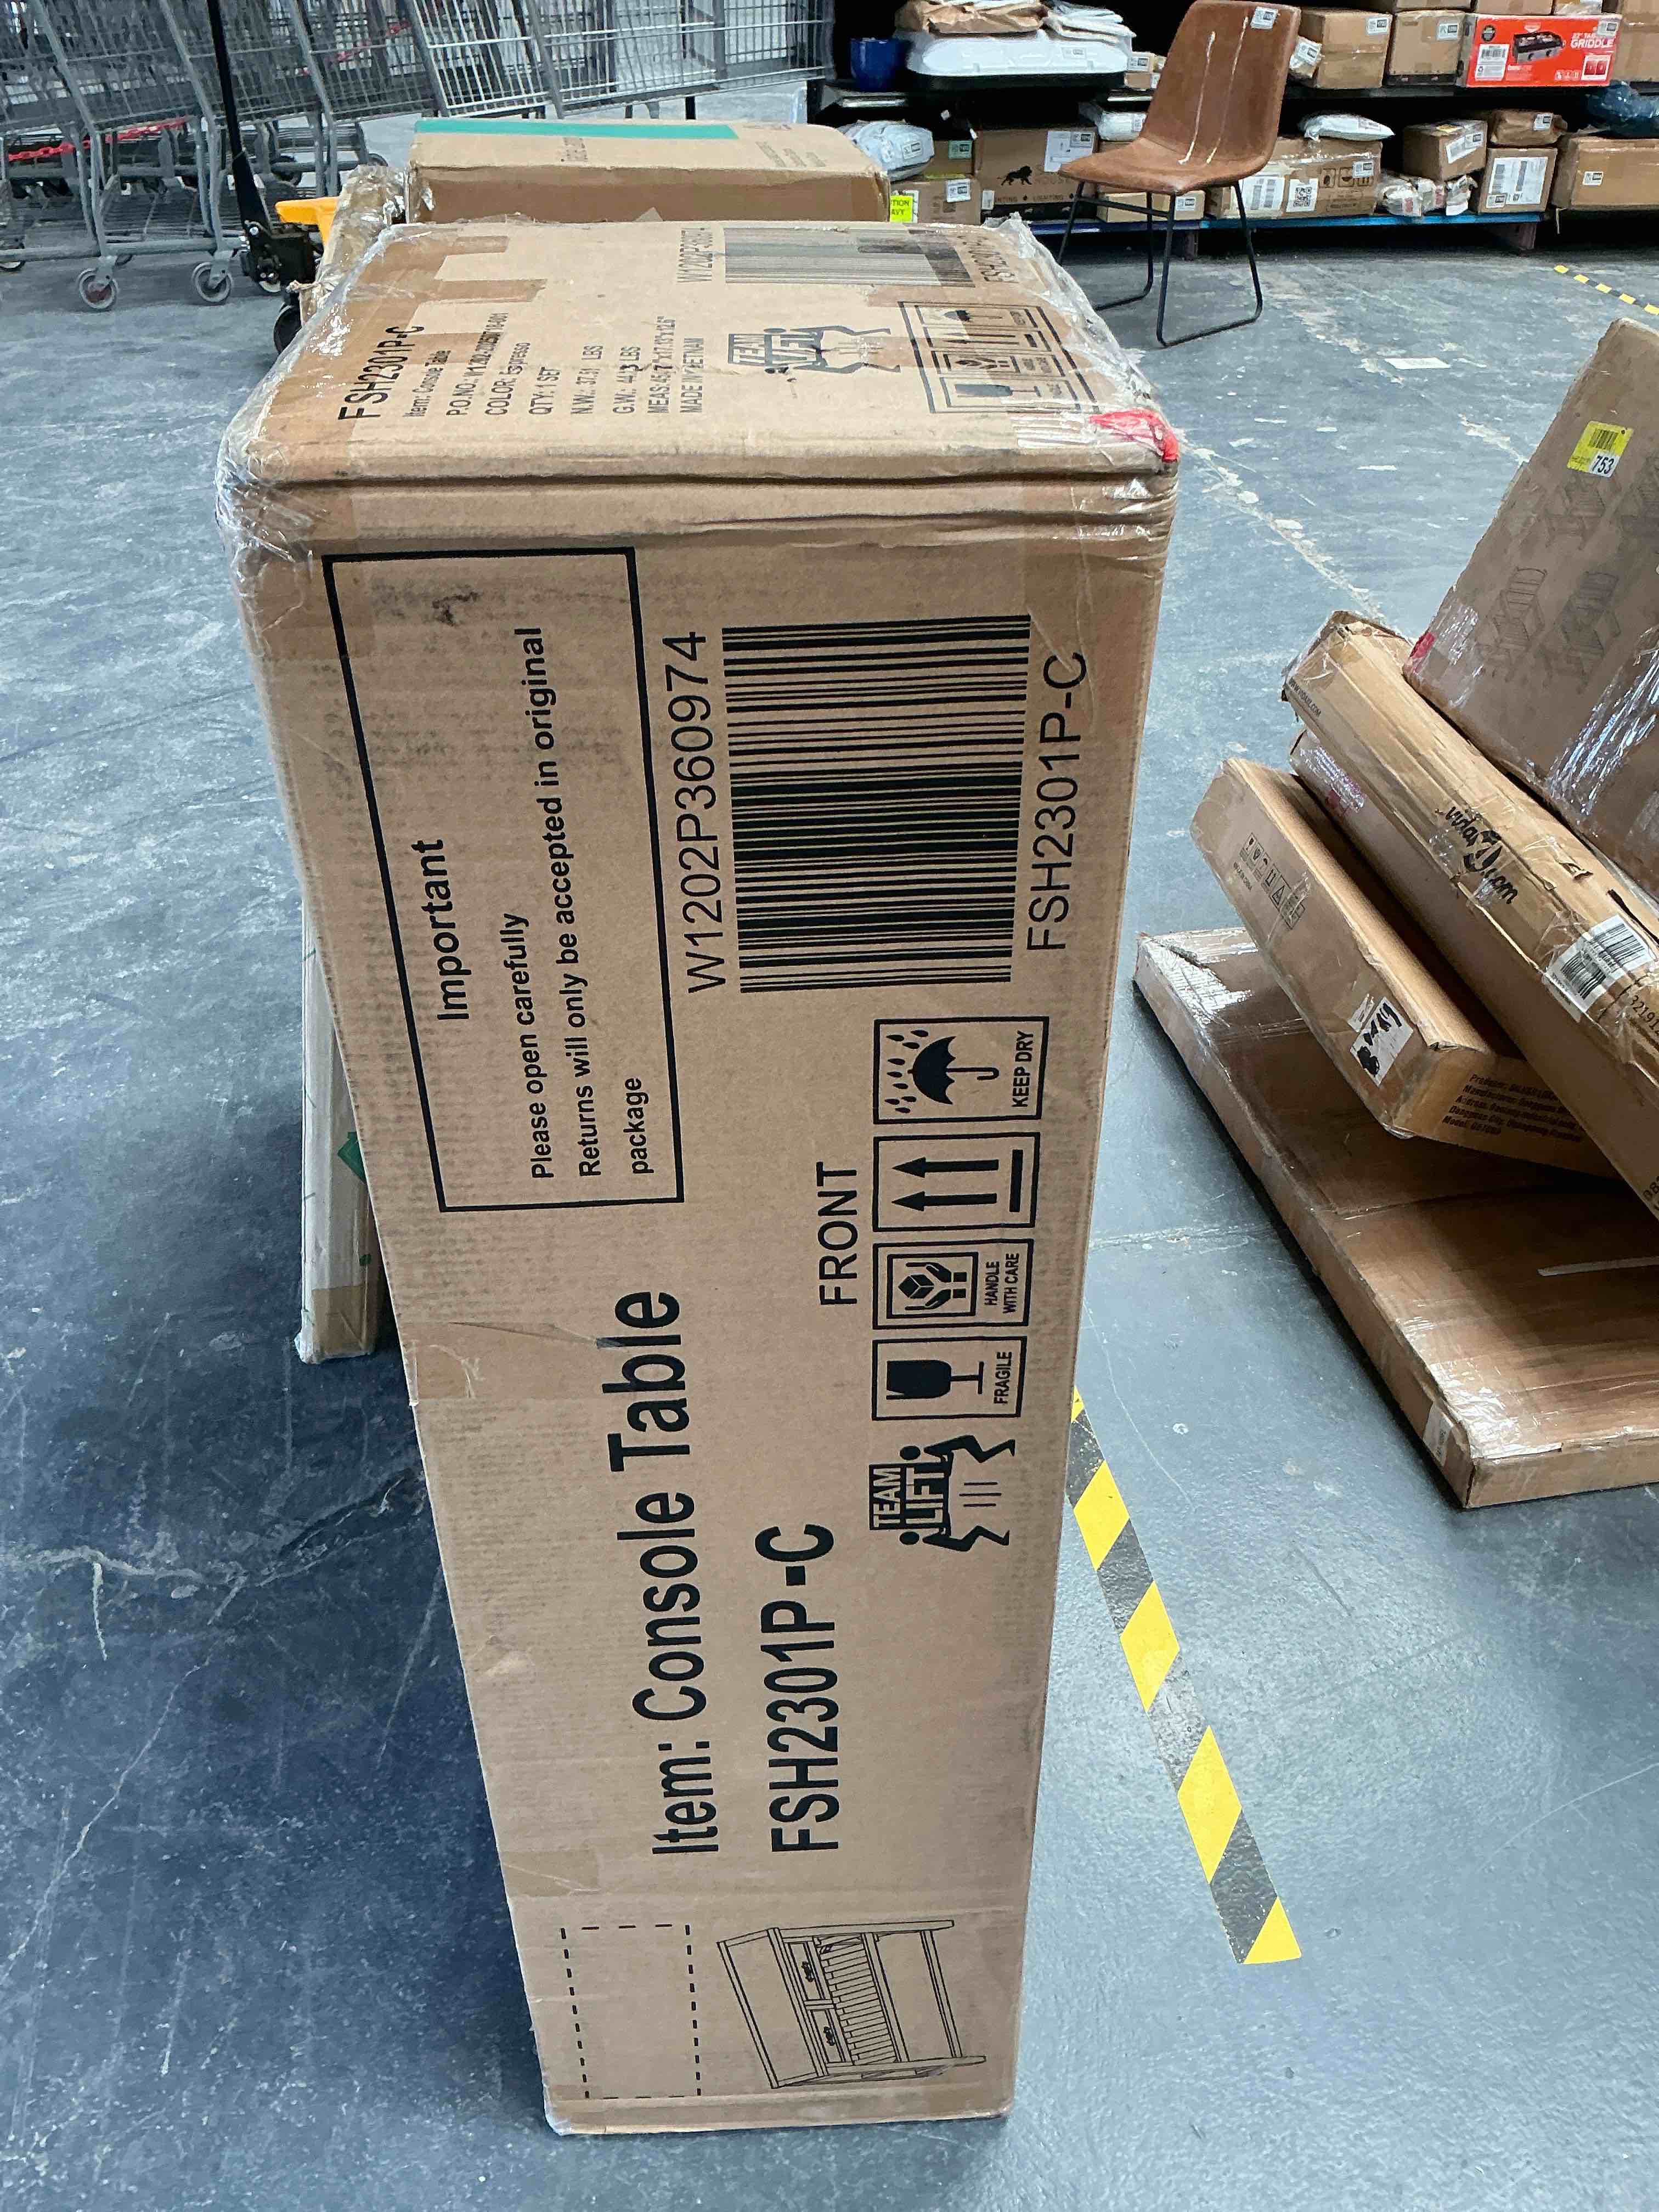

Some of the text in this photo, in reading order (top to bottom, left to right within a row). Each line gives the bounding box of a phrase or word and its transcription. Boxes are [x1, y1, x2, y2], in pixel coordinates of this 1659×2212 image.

[1571, 39, 1614, 48] GRIDDLE
[338, 326, 425, 421] FSH2301P-C
[412, 367, 444, 394] Console
[537, 366, 561, 382] SET
[581, 345, 604, 360] LBS
[620, 346, 641, 362] LBS
[402, 395, 430, 417] Item:
[484, 378, 517, 416] COLOR:
[528, 391, 555, 415] QTY:
[680, 386, 703, 414] MADE
[1592, 455, 1615, 475] 753
[662, 632, 726, 993] W1202P360974
[1027, 652, 1086, 950] FSH2301P-C
[411, 839, 471, 1020] Important
[514, 628, 601, 1176] Returns will only be accepted in original
[500, 913, 554, 1178] Please open carefully
[1012, 1031, 1033, 1107] KEEP DRY
[623, 1079, 654, 1173] package
[816, 1161, 857, 1305] FRONT
[984, 1261, 1000, 1305] HANDLE
[1003, 1253, 1019, 1313] WITH CARE
[994, 1352, 1012, 1404] FRAGILE
[874, 1467, 901, 1527] TEAM
[905, 1466, 944, 1524] LIFT
[596, 1290, 718, 1854] Item: Console Table
[755, 1525, 839, 1852] FSH2301P-C
